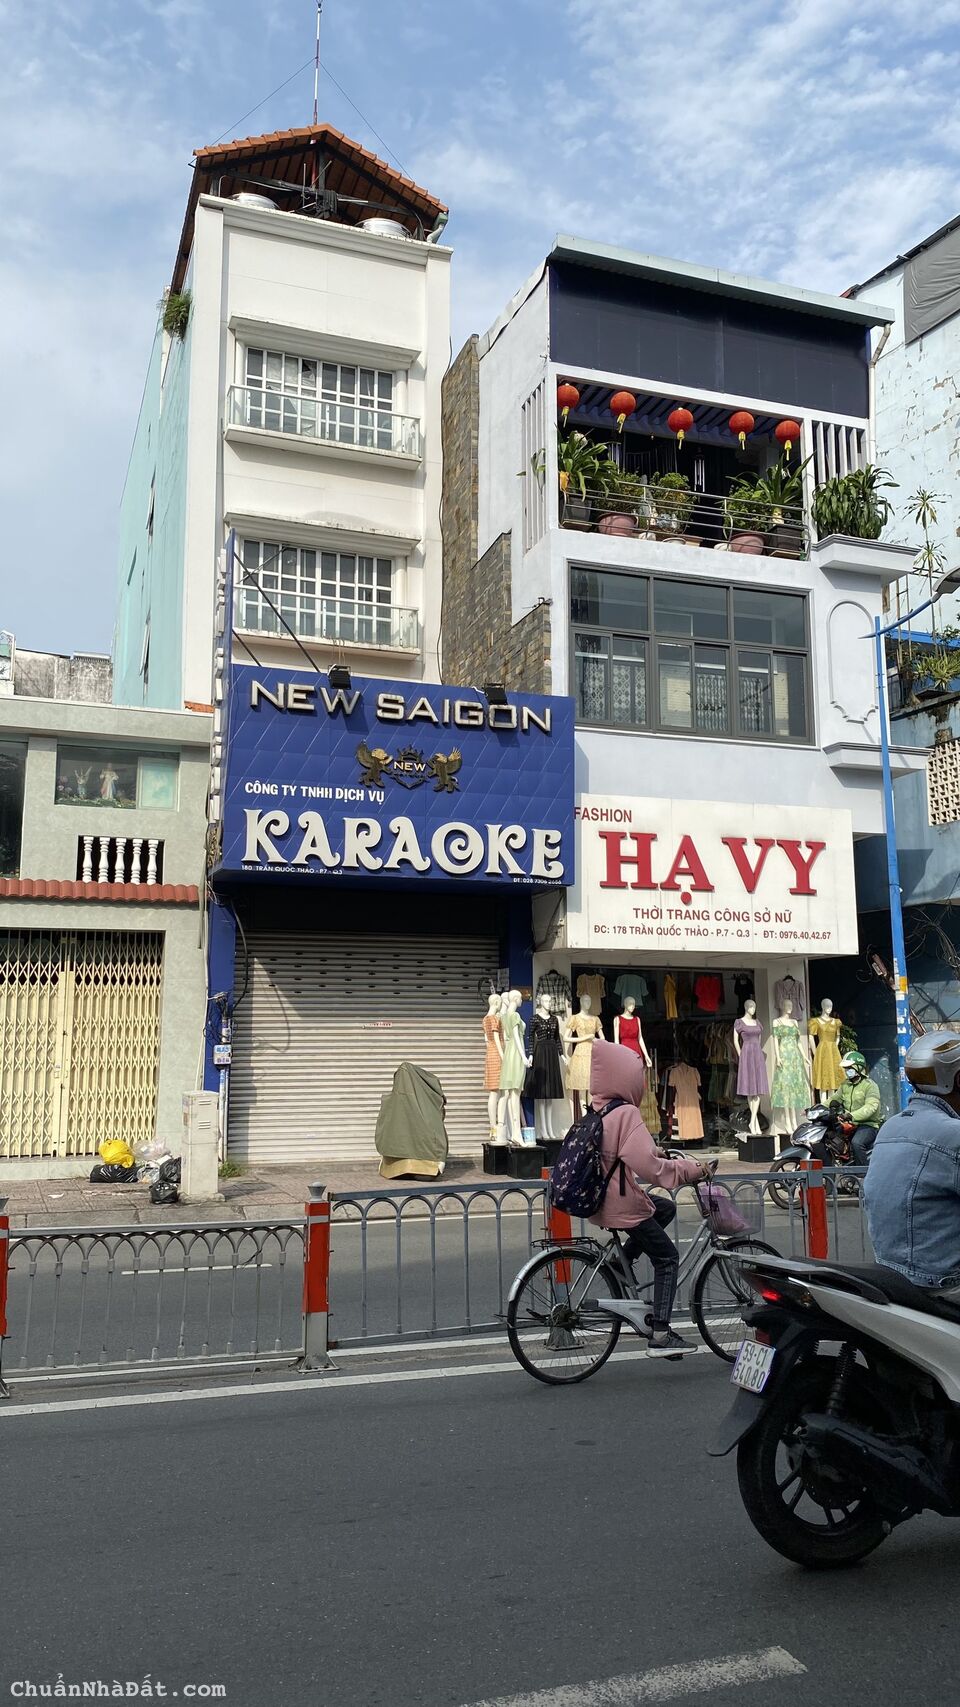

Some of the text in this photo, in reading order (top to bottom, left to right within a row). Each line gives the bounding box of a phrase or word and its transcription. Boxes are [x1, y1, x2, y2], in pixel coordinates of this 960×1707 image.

[250, 680, 552, 733] NEW SAIGON
[393, 761, 426, 772] NEW
[245, 780, 385, 805] CÔNG TY TNHH DỊCH VỤ
[574, 807, 632, 823] FASHION
[241, 808, 565, 879] KARAOKE
[598, 830, 826, 906] HẠ VY
[633, 905, 792, 923] THỜI TRANG CÔNG SỞ NỮ
[594, 925, 610, 934] ĐC:
[612, 926, 627, 934] 178
[629, 923, 654, 935] TRẦN
[656, 924, 682, 936] QUỐC
[684, 925, 709, 937] THẢO
[716, 929, 729, 937] P.7
[736, 929, 750, 938] Q.3
[763, 930, 777, 939] ĐT:
[779, 930, 831, 940] 0976.40.42.67
